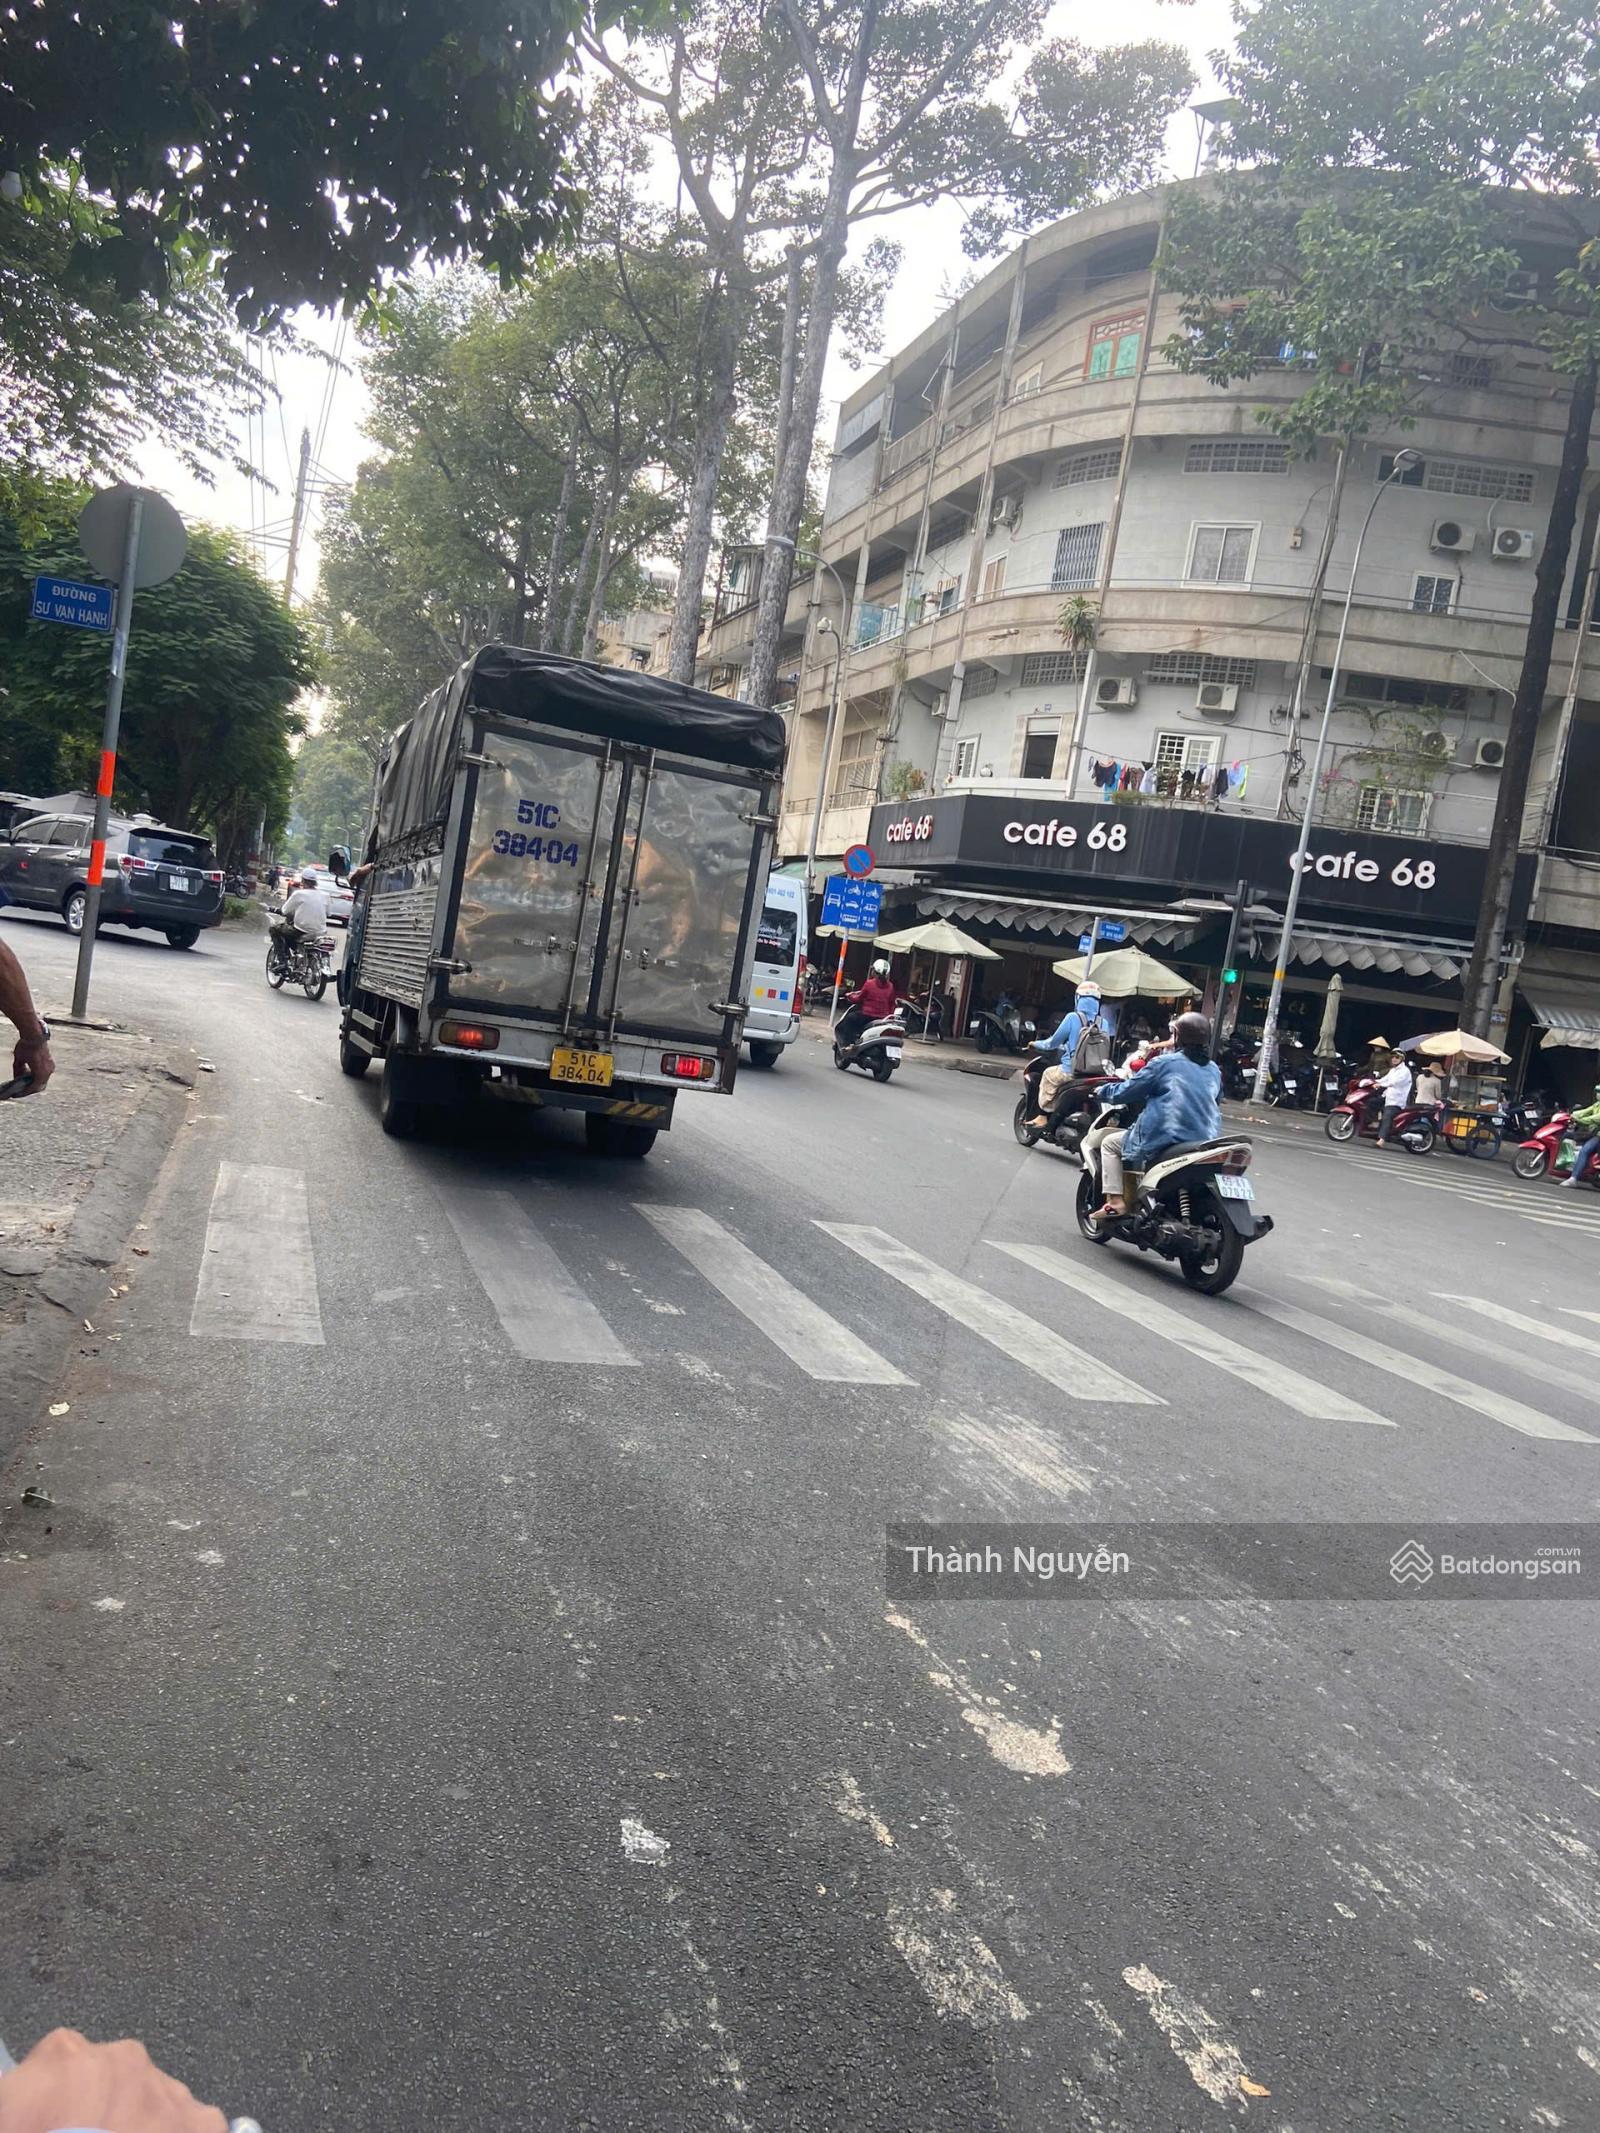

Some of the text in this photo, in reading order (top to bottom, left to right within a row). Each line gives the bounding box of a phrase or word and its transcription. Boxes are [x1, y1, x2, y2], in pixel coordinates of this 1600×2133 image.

[52, 585, 97, 603] ĐƯỜNG
[35, 600, 51, 615] SƯ
[79, 608, 107, 626] HẠNH
[517, 799, 559, 829] 51C
[886, 814, 933, 842] cafe 68
[1003, 819, 1127, 852] cafe 68
[1289, 851, 1436, 890] cafe 68
[570, 1052, 597, 1067] 51C
[557, 1065, 605, 1083] 384.04
